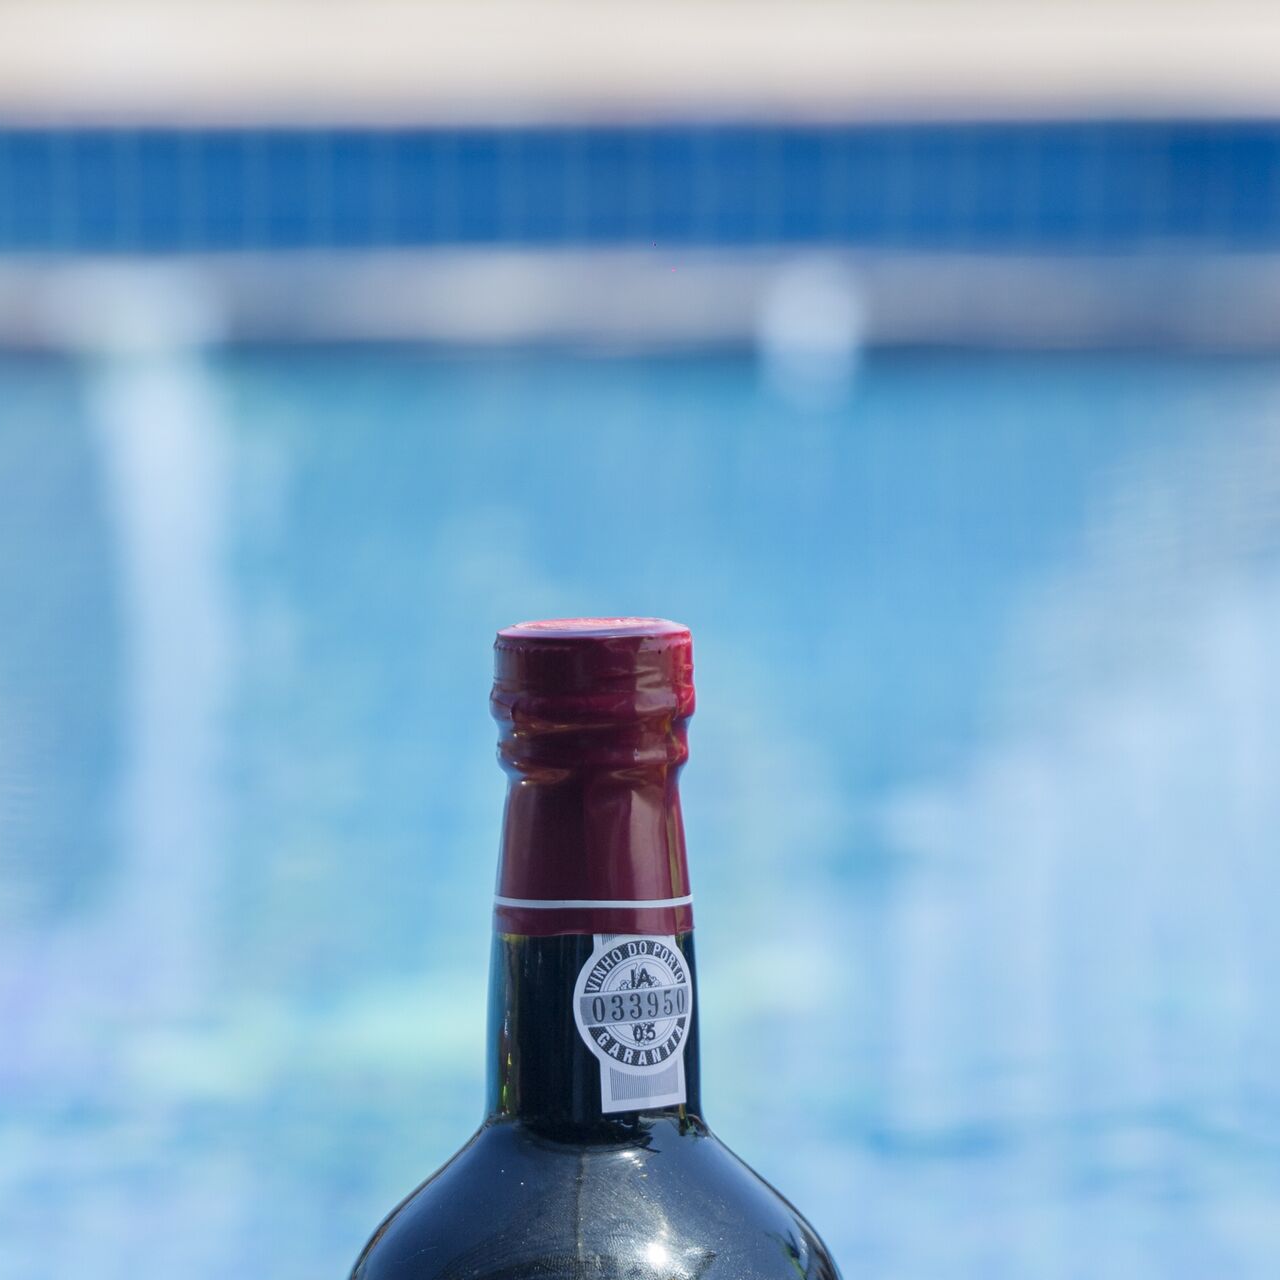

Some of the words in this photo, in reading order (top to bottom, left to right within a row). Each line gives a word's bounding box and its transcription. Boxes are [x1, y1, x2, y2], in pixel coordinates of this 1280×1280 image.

[586, 950, 622, 991] VINHO
[628, 941, 647, 956] DO
[653, 944, 684, 983] PORTO
[592, 988, 685, 1023] 033950
[597, 1024, 684, 1065] GARANTIA
[633, 1024, 656, 1041] 05
